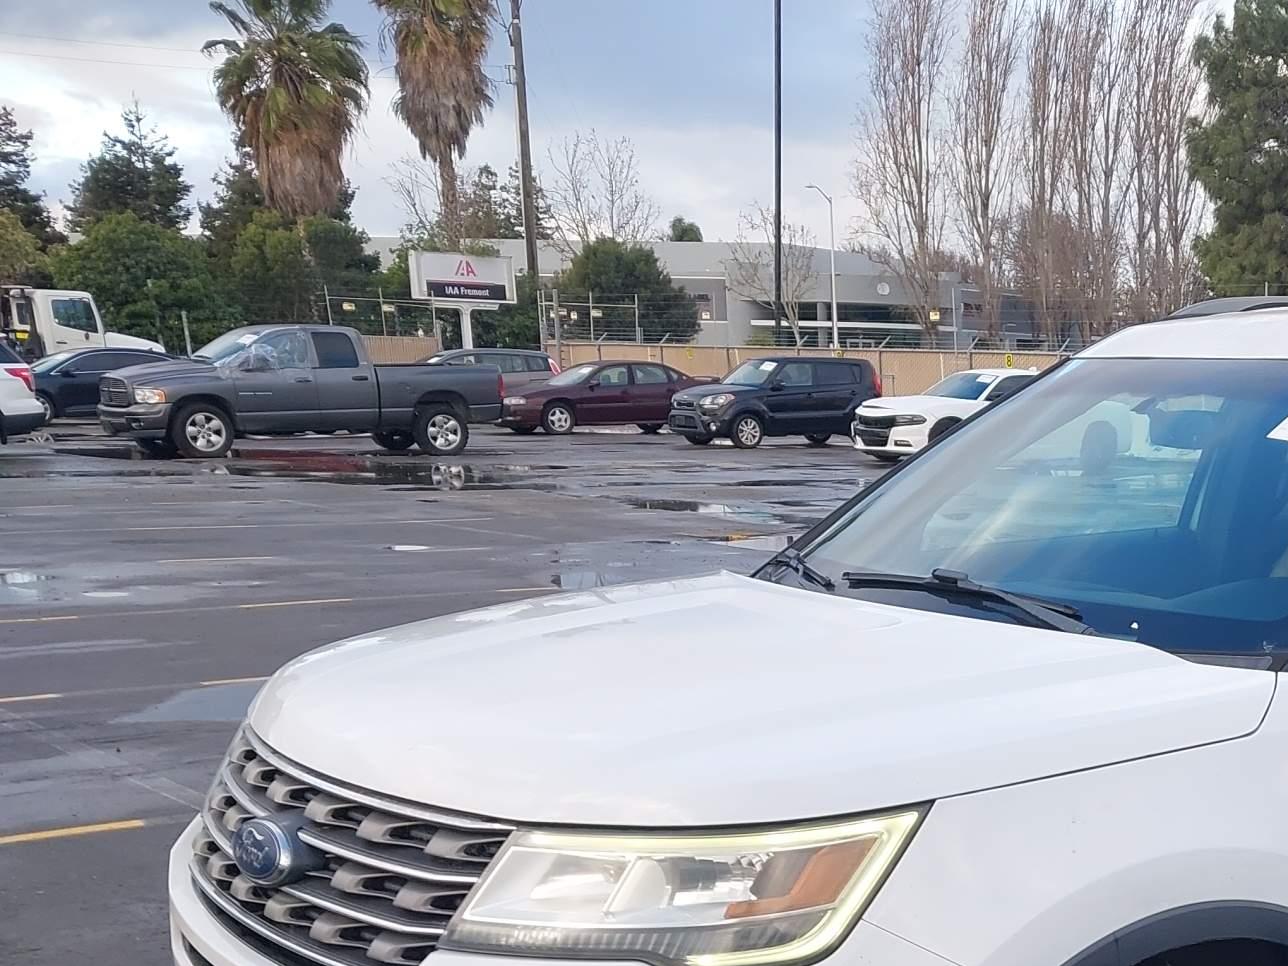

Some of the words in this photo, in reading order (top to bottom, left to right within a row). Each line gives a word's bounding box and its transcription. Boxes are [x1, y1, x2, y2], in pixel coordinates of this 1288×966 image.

[444, 286, 459, 296] IAA
[461, 286, 490, 297] Fremont
[1006, 355, 1012, 367] 8
